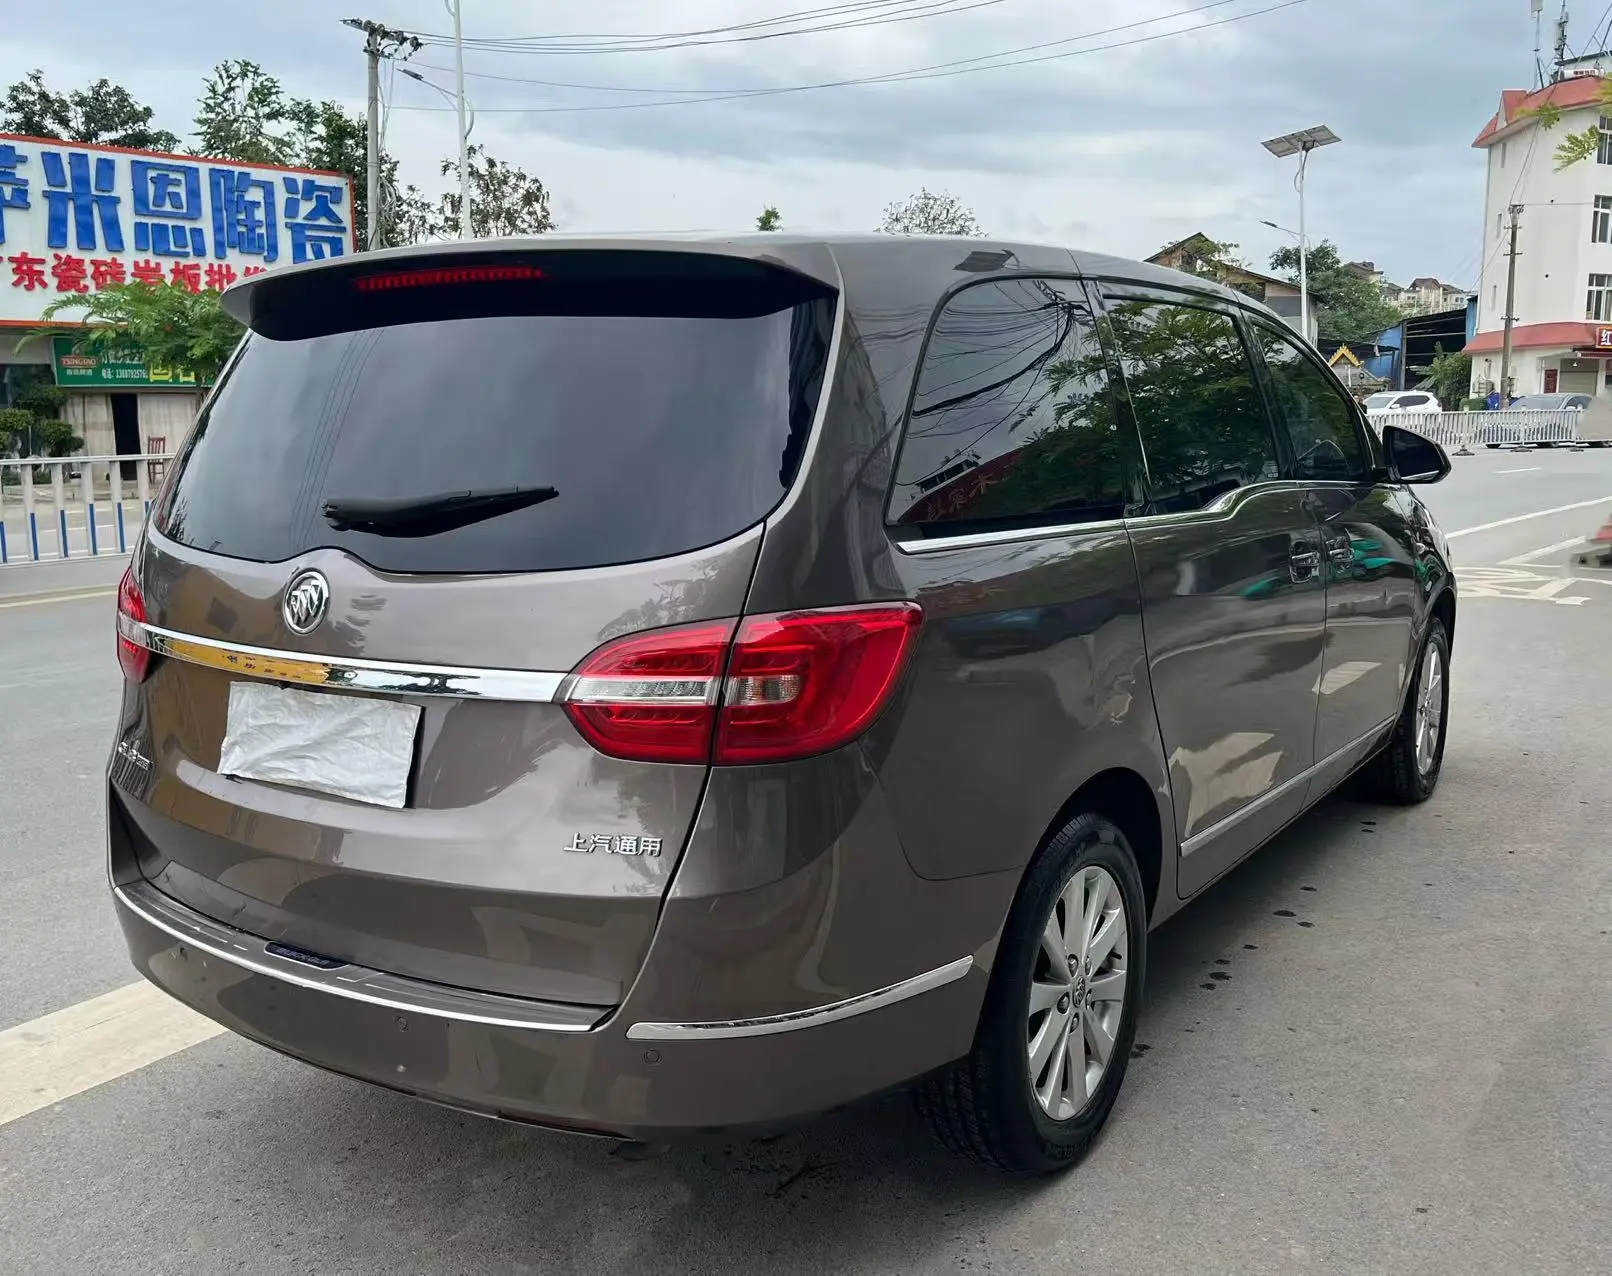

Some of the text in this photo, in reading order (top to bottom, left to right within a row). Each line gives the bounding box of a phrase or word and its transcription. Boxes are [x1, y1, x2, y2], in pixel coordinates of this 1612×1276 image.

[0, 252, 267, 294] 东瓷砖岩板批
[563, 832, 663, 857] 上汽通用
